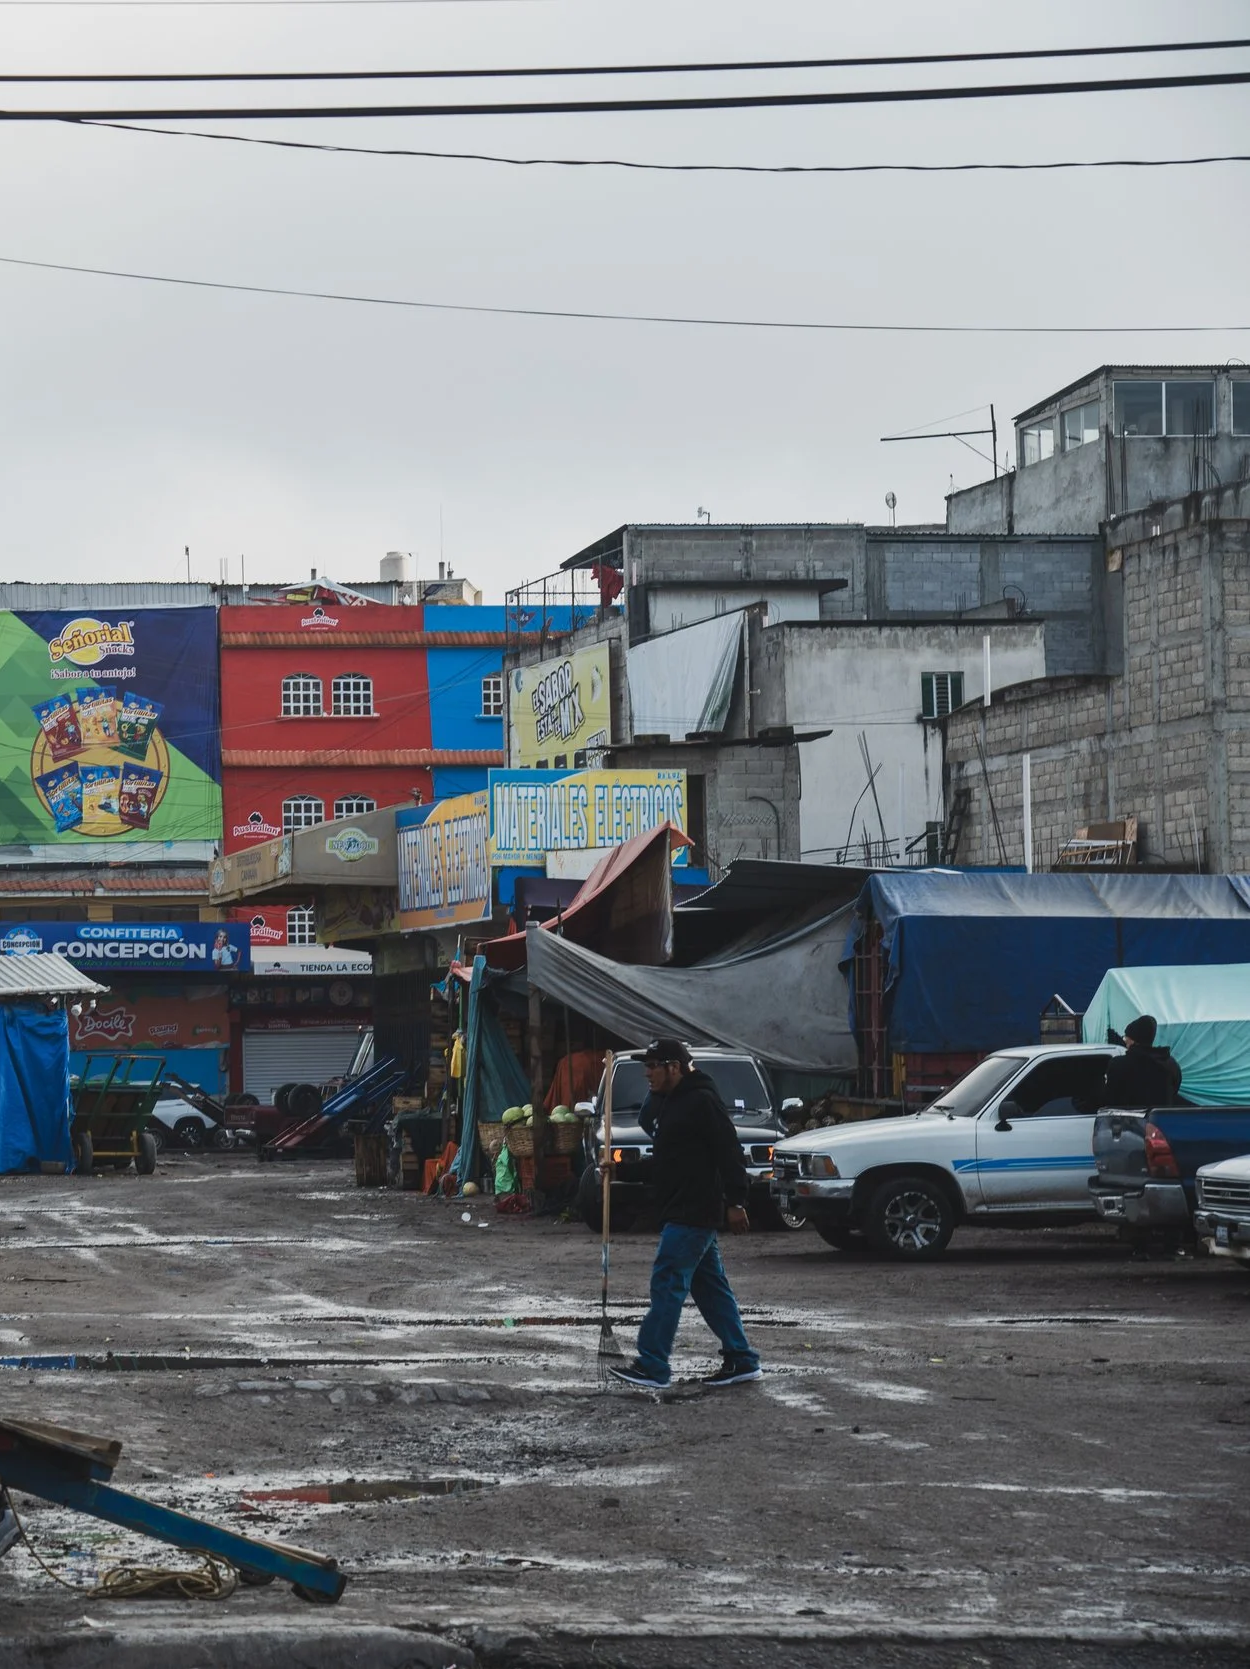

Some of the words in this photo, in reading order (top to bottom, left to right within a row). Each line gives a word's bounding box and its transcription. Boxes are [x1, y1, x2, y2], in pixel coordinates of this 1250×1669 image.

[49, 623, 134, 661] Señorial
[99, 644, 134, 655] Snacks
[90, 669, 102, 678] tu
[102, 667, 136, 680] antojo!
[538, 661, 573, 716] SABOR
[559, 682, 584, 741] MIX
[495, 782, 589, 850] MATERIALES
[234, 823, 281, 837] Australian
[397, 822, 444, 913] MATERIALES
[79, 926, 179, 939] CONFITERÍA
[52, 938, 207, 959] CONCEPCIÓN
[300, 964, 332, 972] TIENDA
[337, 964, 348, 972] LA
[84, 1014, 127, 1032] Docile
